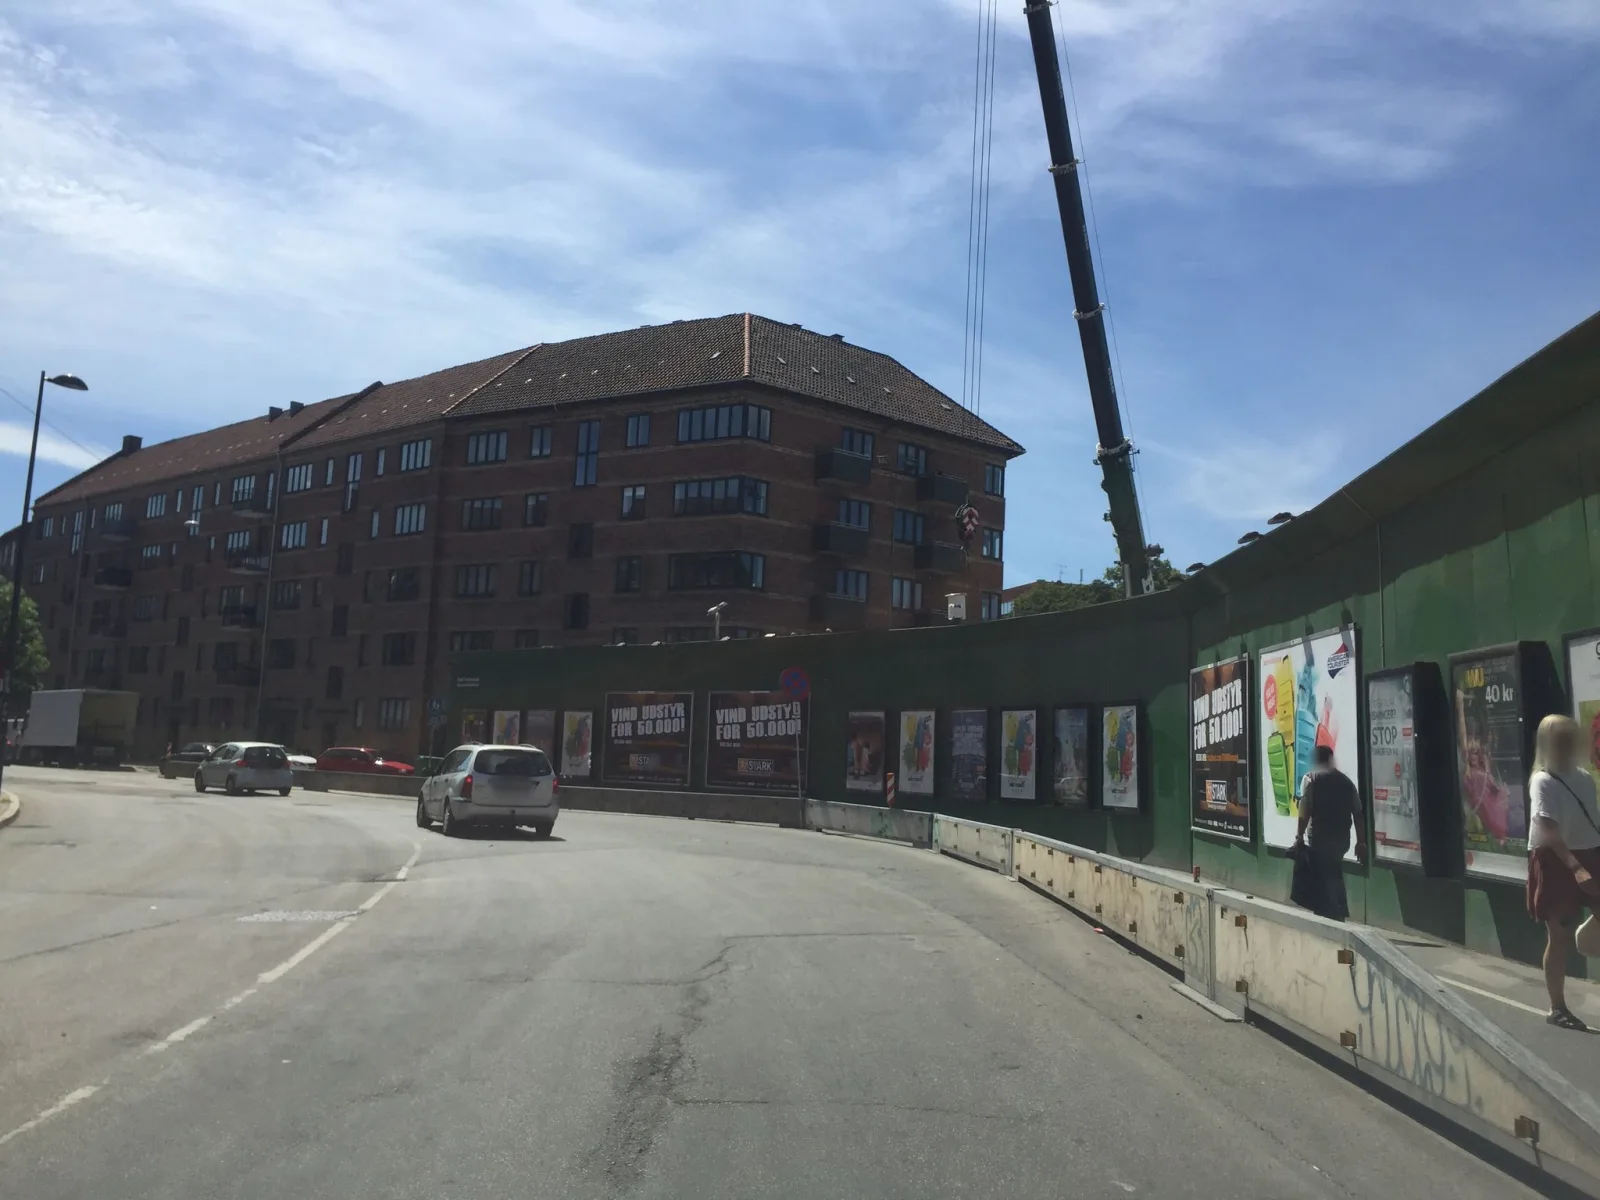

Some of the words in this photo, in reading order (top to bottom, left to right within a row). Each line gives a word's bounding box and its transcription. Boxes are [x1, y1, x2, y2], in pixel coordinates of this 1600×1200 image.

[1194, 693, 1209, 724] VIND
[1212, 678, 1242, 715] UDSTYR
[1485, 684, 1500, 703] 40
[1502, 683, 1514, 702] kr
[611, 706, 638, 722] VIND
[642, 702, 685, 720] UDSTYR
[715, 707, 746, 724] VIND
[751, 701, 801, 722] UDSTYR
[611, 722, 632, 738] FOR
[637, 717, 686, 736] 50.000!
[715, 723, 741, 740] FOR
[746, 719, 802, 739] 50.000!
[1194, 721, 1207, 751] FOR
[1209, 706, 1243, 745] 50.000!
[1372, 725, 1397, 745] STOP
[748, 760, 773, 772] STARK
[1211, 783, 1228, 801] STARK
